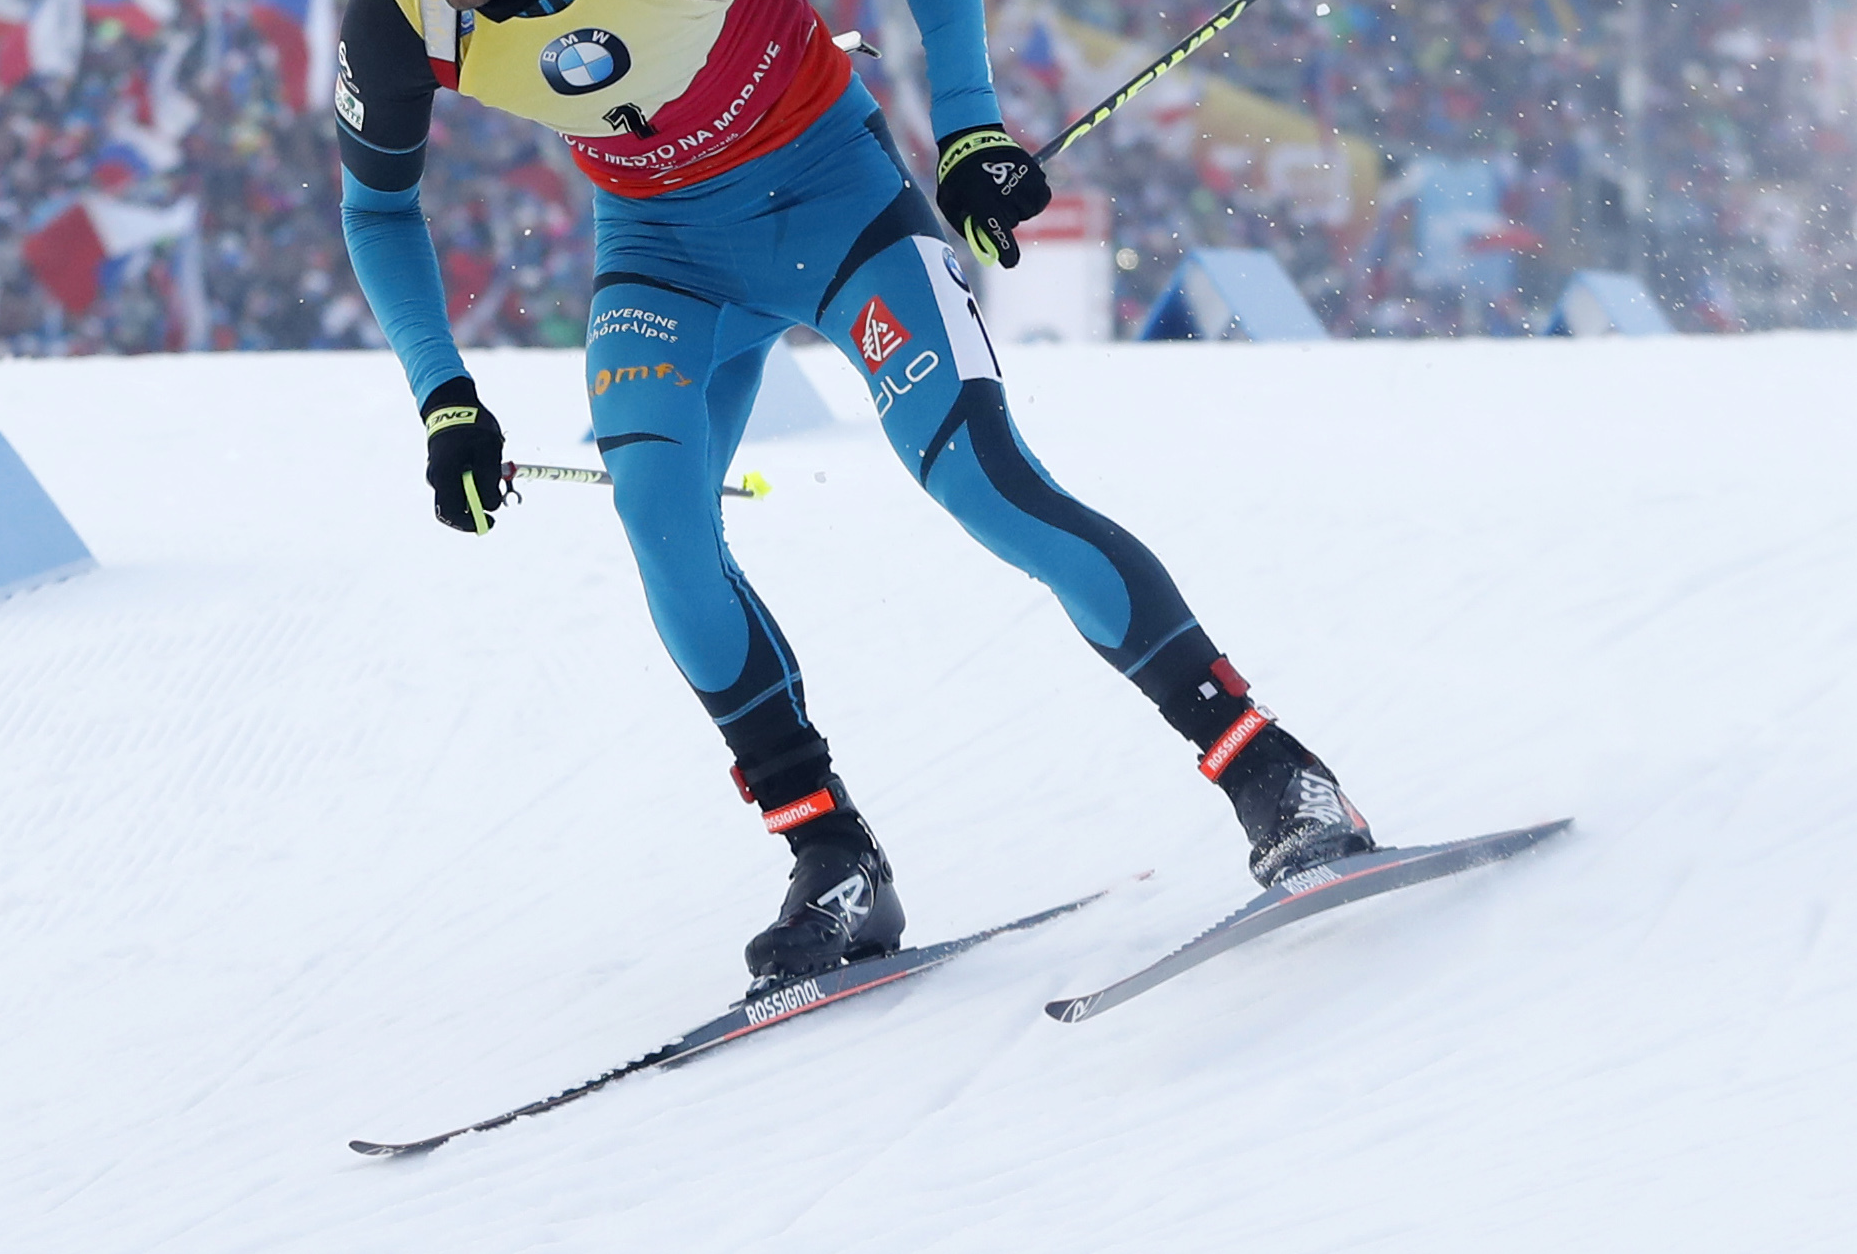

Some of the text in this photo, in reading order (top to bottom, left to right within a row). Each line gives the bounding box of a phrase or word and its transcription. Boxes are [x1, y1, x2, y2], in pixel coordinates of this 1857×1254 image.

[543, 30, 610, 63] BMW
[677, 130, 714, 151] NA
[1001, 164, 1028, 196] odlo
[593, 308, 679, 331] AUVERGNE
[1207, 714, 1262, 772] ROSSIGNOL
[745, 978, 826, 1026] ROSSIGNOL
